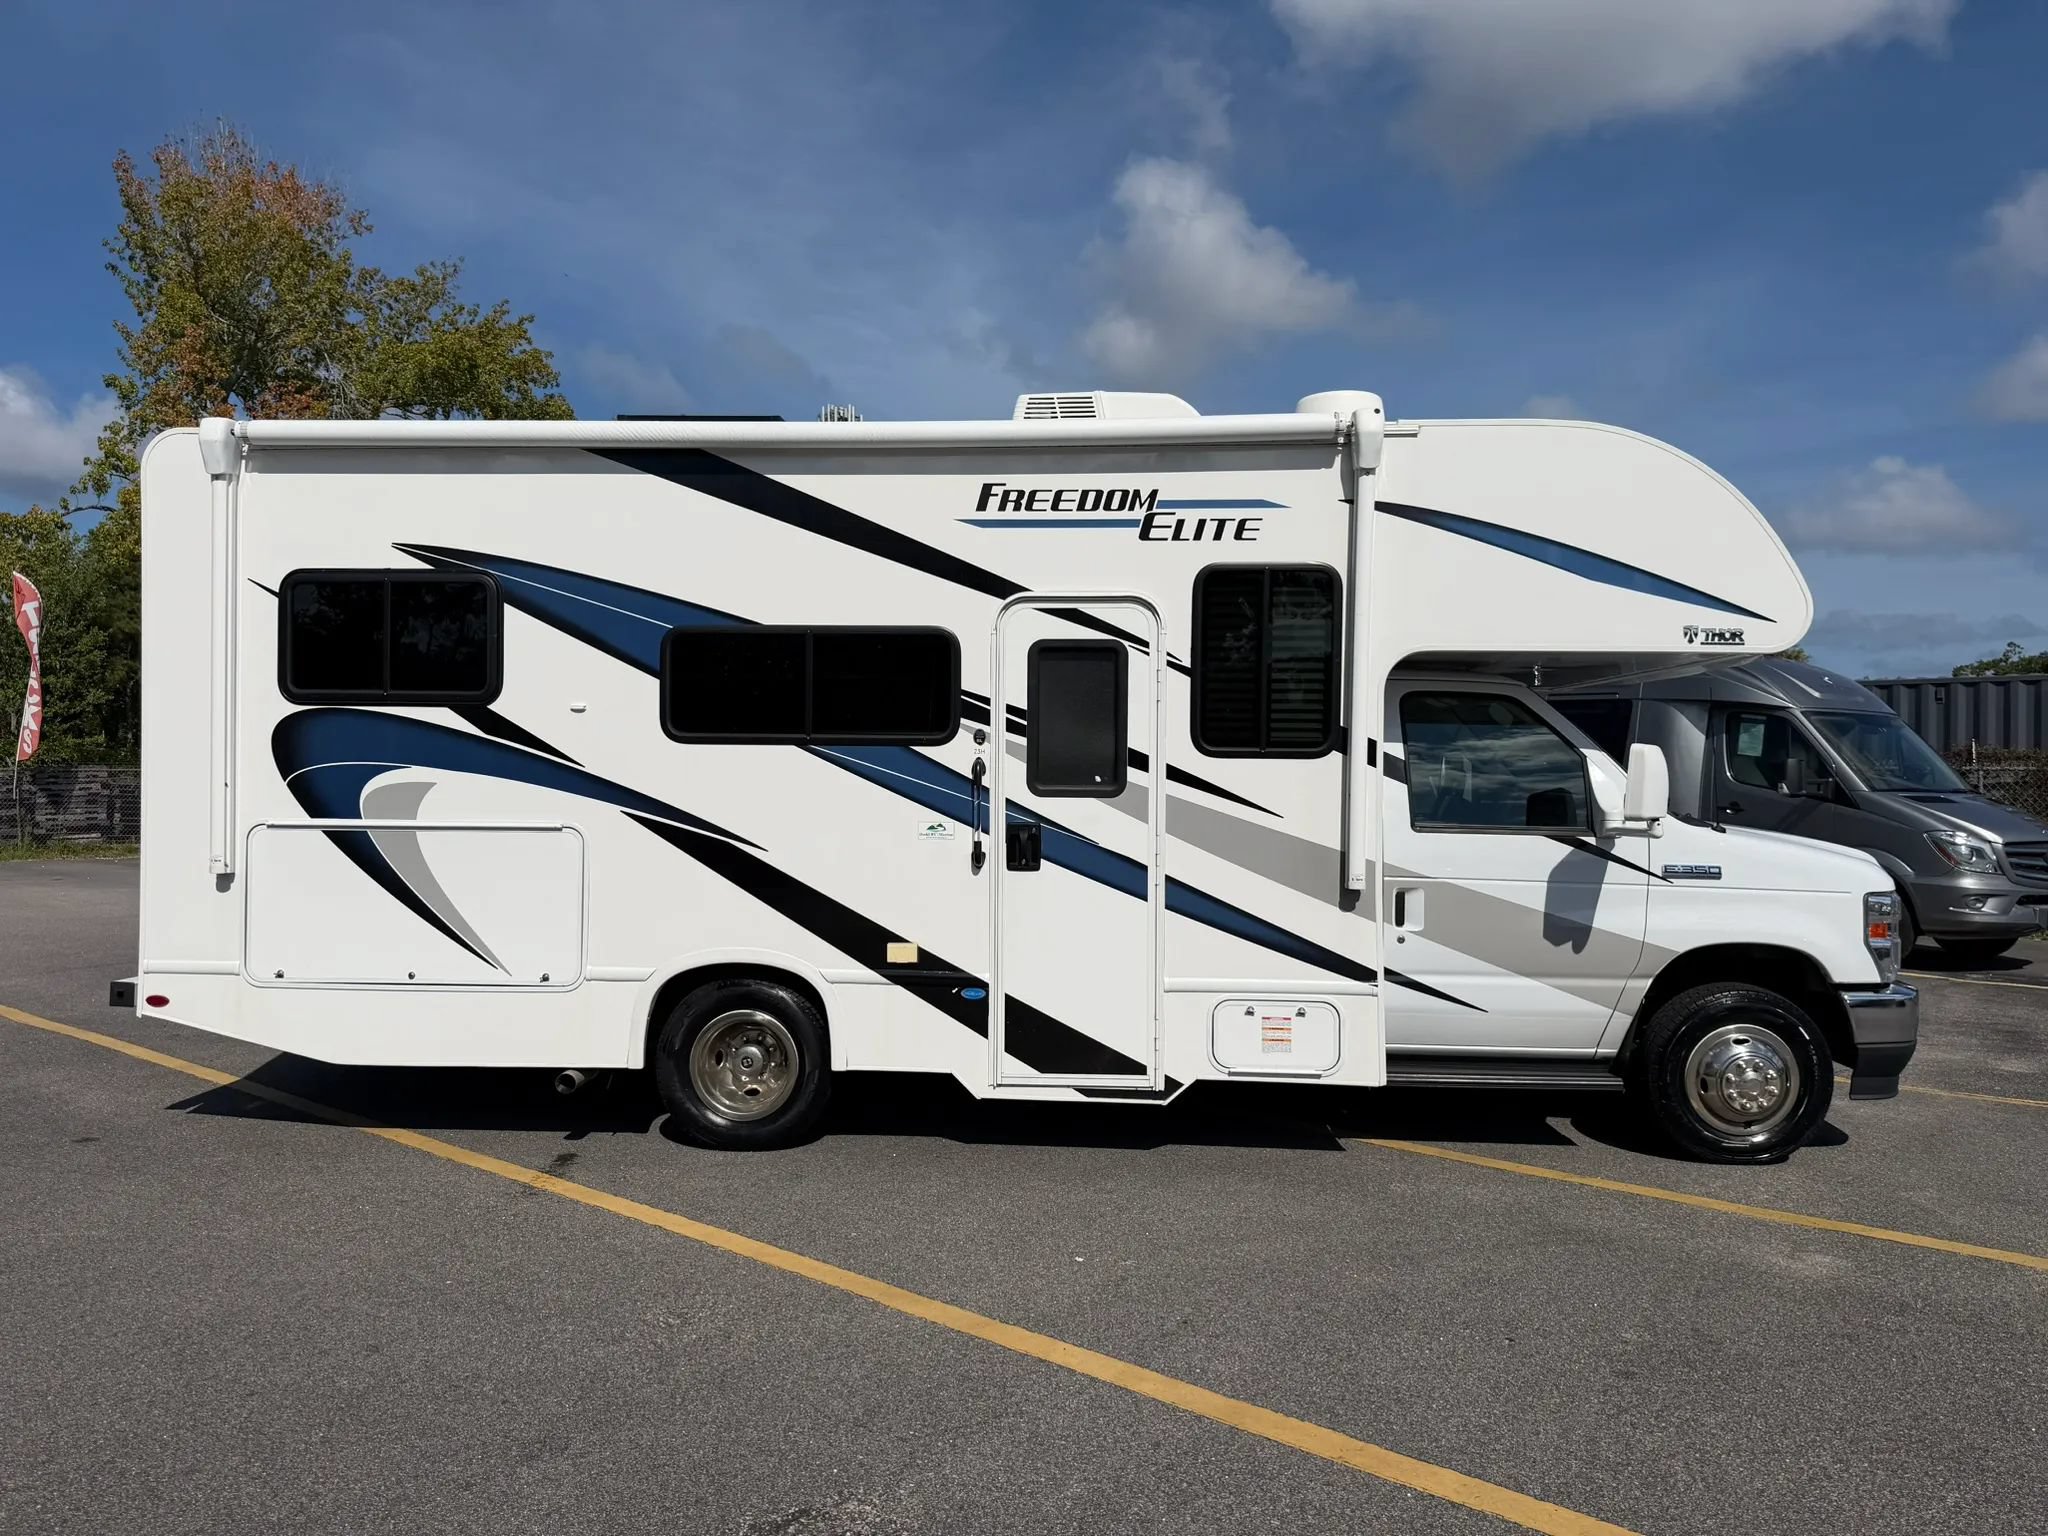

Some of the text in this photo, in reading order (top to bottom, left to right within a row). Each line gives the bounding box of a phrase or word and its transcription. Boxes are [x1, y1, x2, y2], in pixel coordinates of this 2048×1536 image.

[975, 483, 1159, 512] FREEDOM
[1138, 511, 1263, 541] ELITE
[1700, 628, 1745, 642] THOR
